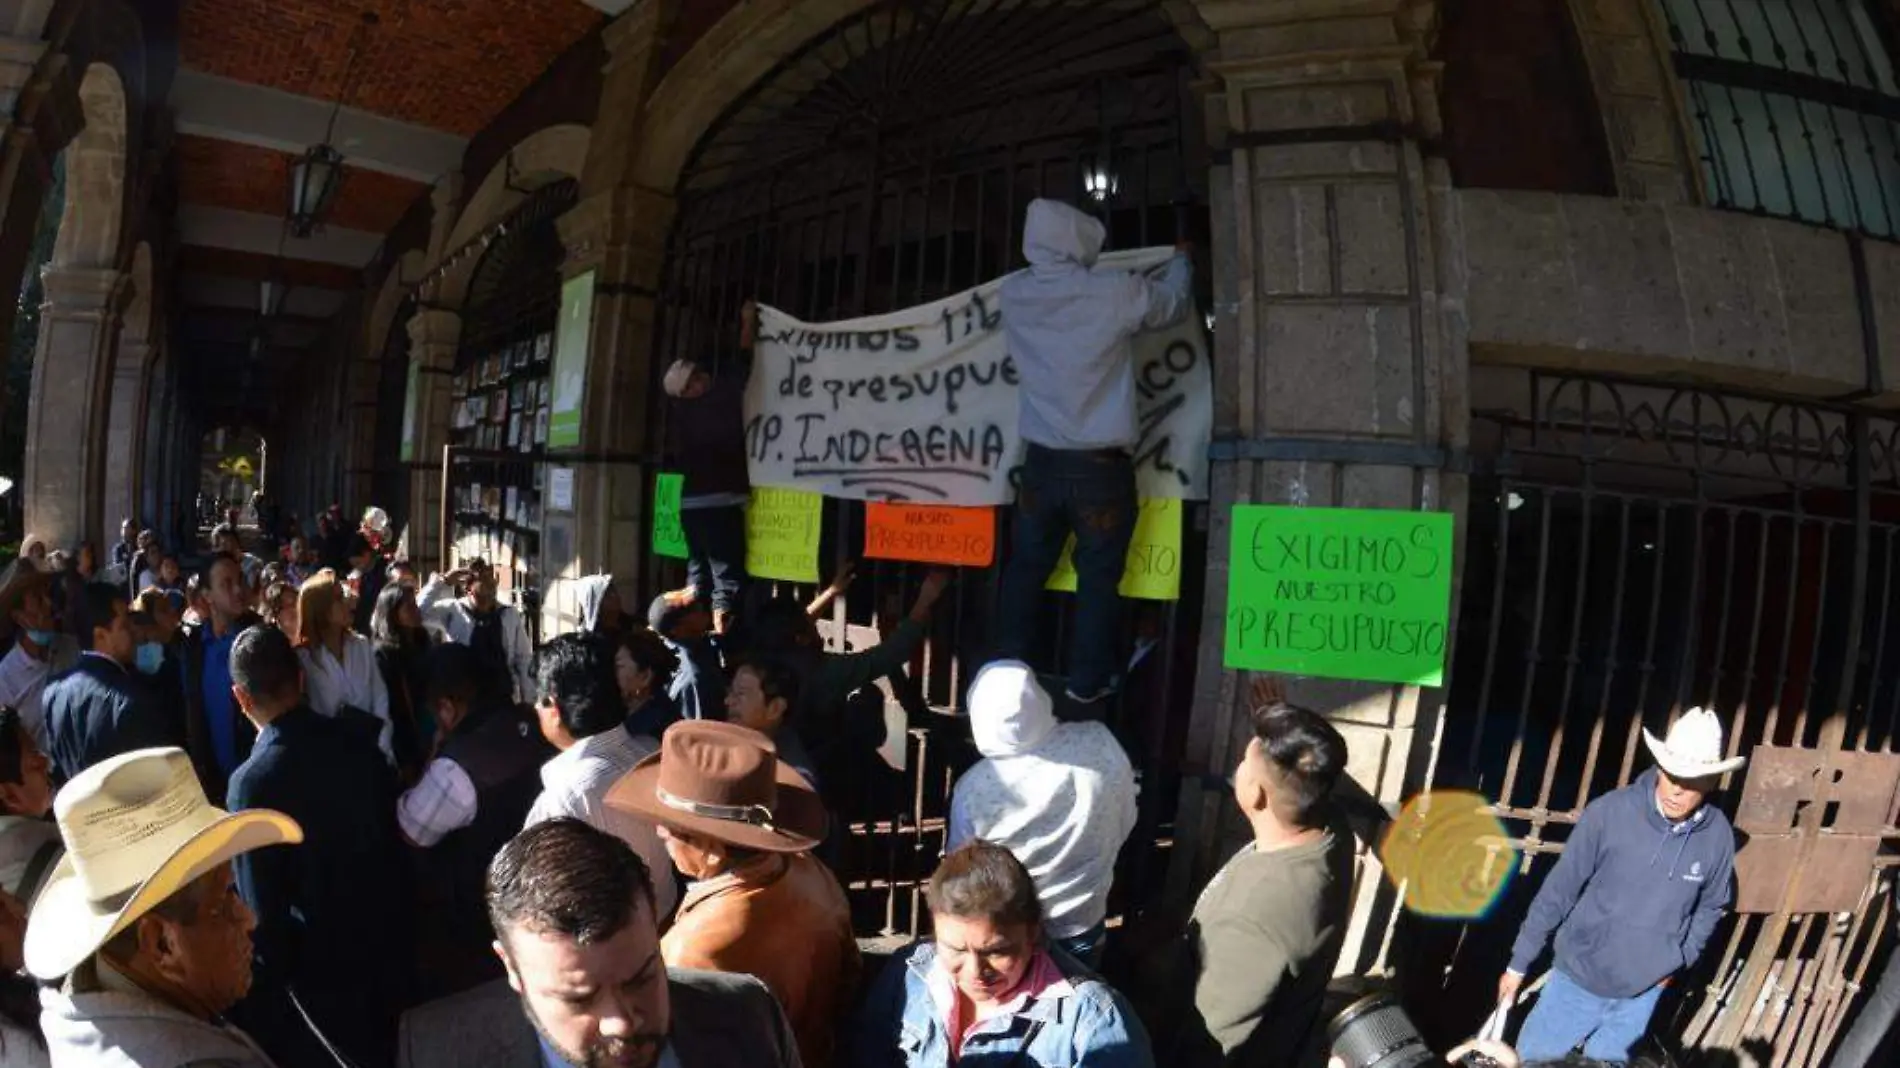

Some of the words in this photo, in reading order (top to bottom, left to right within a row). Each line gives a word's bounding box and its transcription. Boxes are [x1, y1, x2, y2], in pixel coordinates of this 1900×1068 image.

[779, 356, 813, 398] de
[1248, 516, 1440, 579] EXIGIMOS
[1273, 579, 1397, 606] NUESTRO
[1228, 605, 1446, 658] PRESUPUESTO
